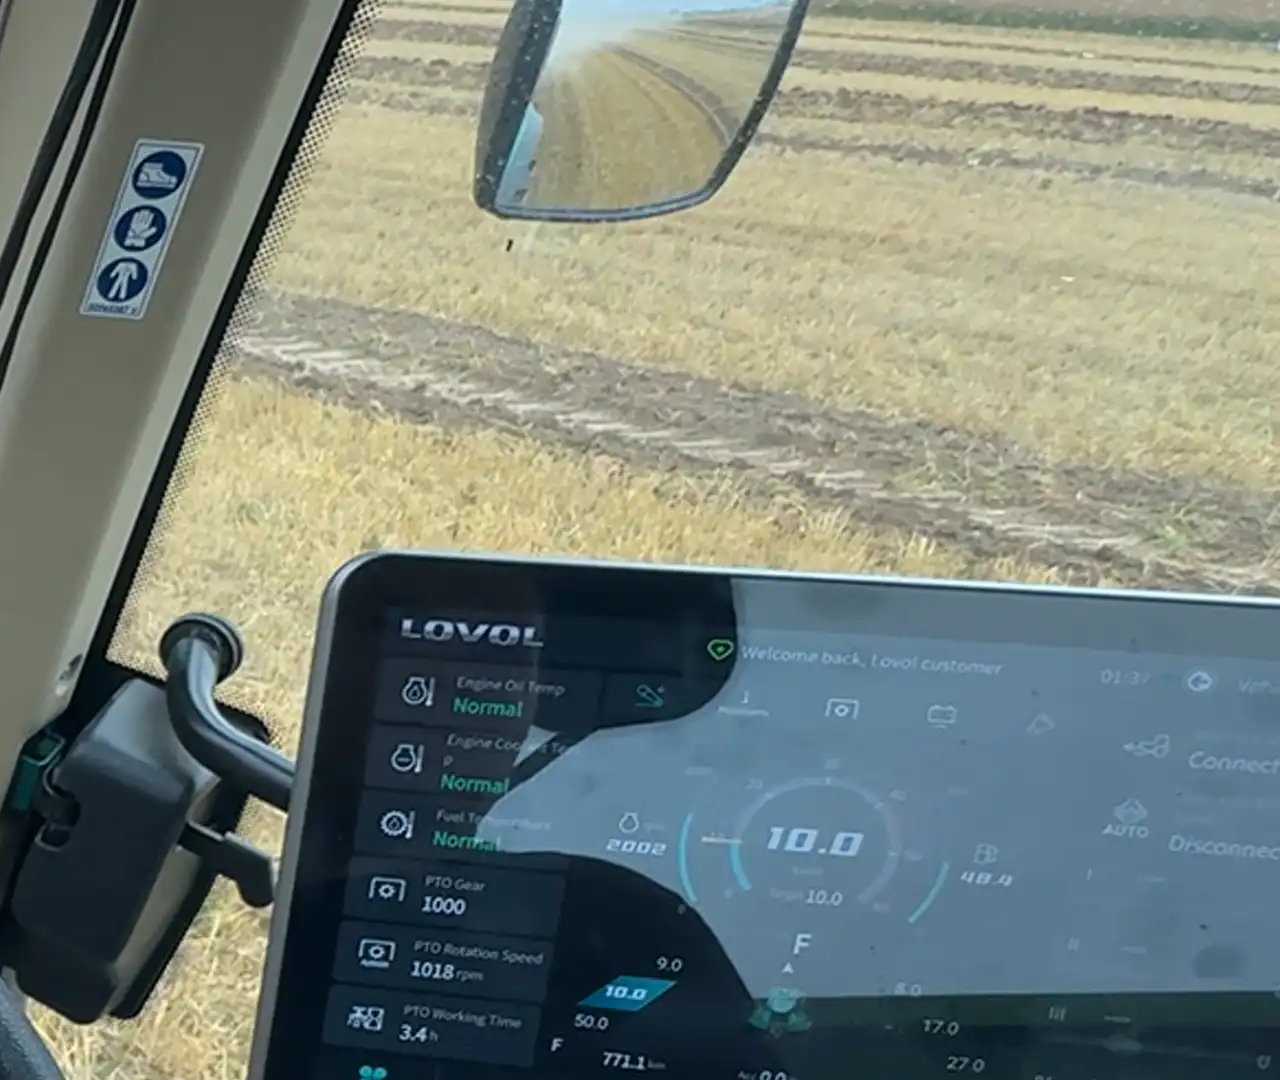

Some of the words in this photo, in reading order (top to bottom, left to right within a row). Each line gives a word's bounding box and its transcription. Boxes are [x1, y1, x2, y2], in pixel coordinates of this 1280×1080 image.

[400, 618, 544, 647] LOVOL
[742, 645, 818, 663] Welcome
[921, 658, 1003, 676] customer
[456, 676, 502, 692] Engine
[453, 698, 523, 718] Normal
[441, 773, 510, 793] Normal
[1102, 824, 1149, 838] AUTO
[432, 831, 503, 852] Normal
[606, 838, 666, 856] 2002
[767, 827, 864, 857] 10.0
[425, 874, 452, 888] PTO
[455, 877, 486, 892] Gear
[421, 896, 467, 915] 1000
[805, 889, 843, 906] 10.0
[414, 939, 441, 954] PTO
[444, 943, 498, 960] Rotation
[501, 949, 544, 965] Speed
[793, 933, 812, 954] F
[410, 960, 455, 980] 1018
[656, 955, 683, 973] 9.0
[403, 1004, 430, 1019] PTO
[432, 1008, 486, 1027] Working
[489, 1013, 522, 1029] Time
[574, 1013, 610, 1031] 50.0
[398, 1024, 428, 1043] 3.4
[551, 1037, 564, 1052] F
[602, 1051, 646, 1071] 771.1
